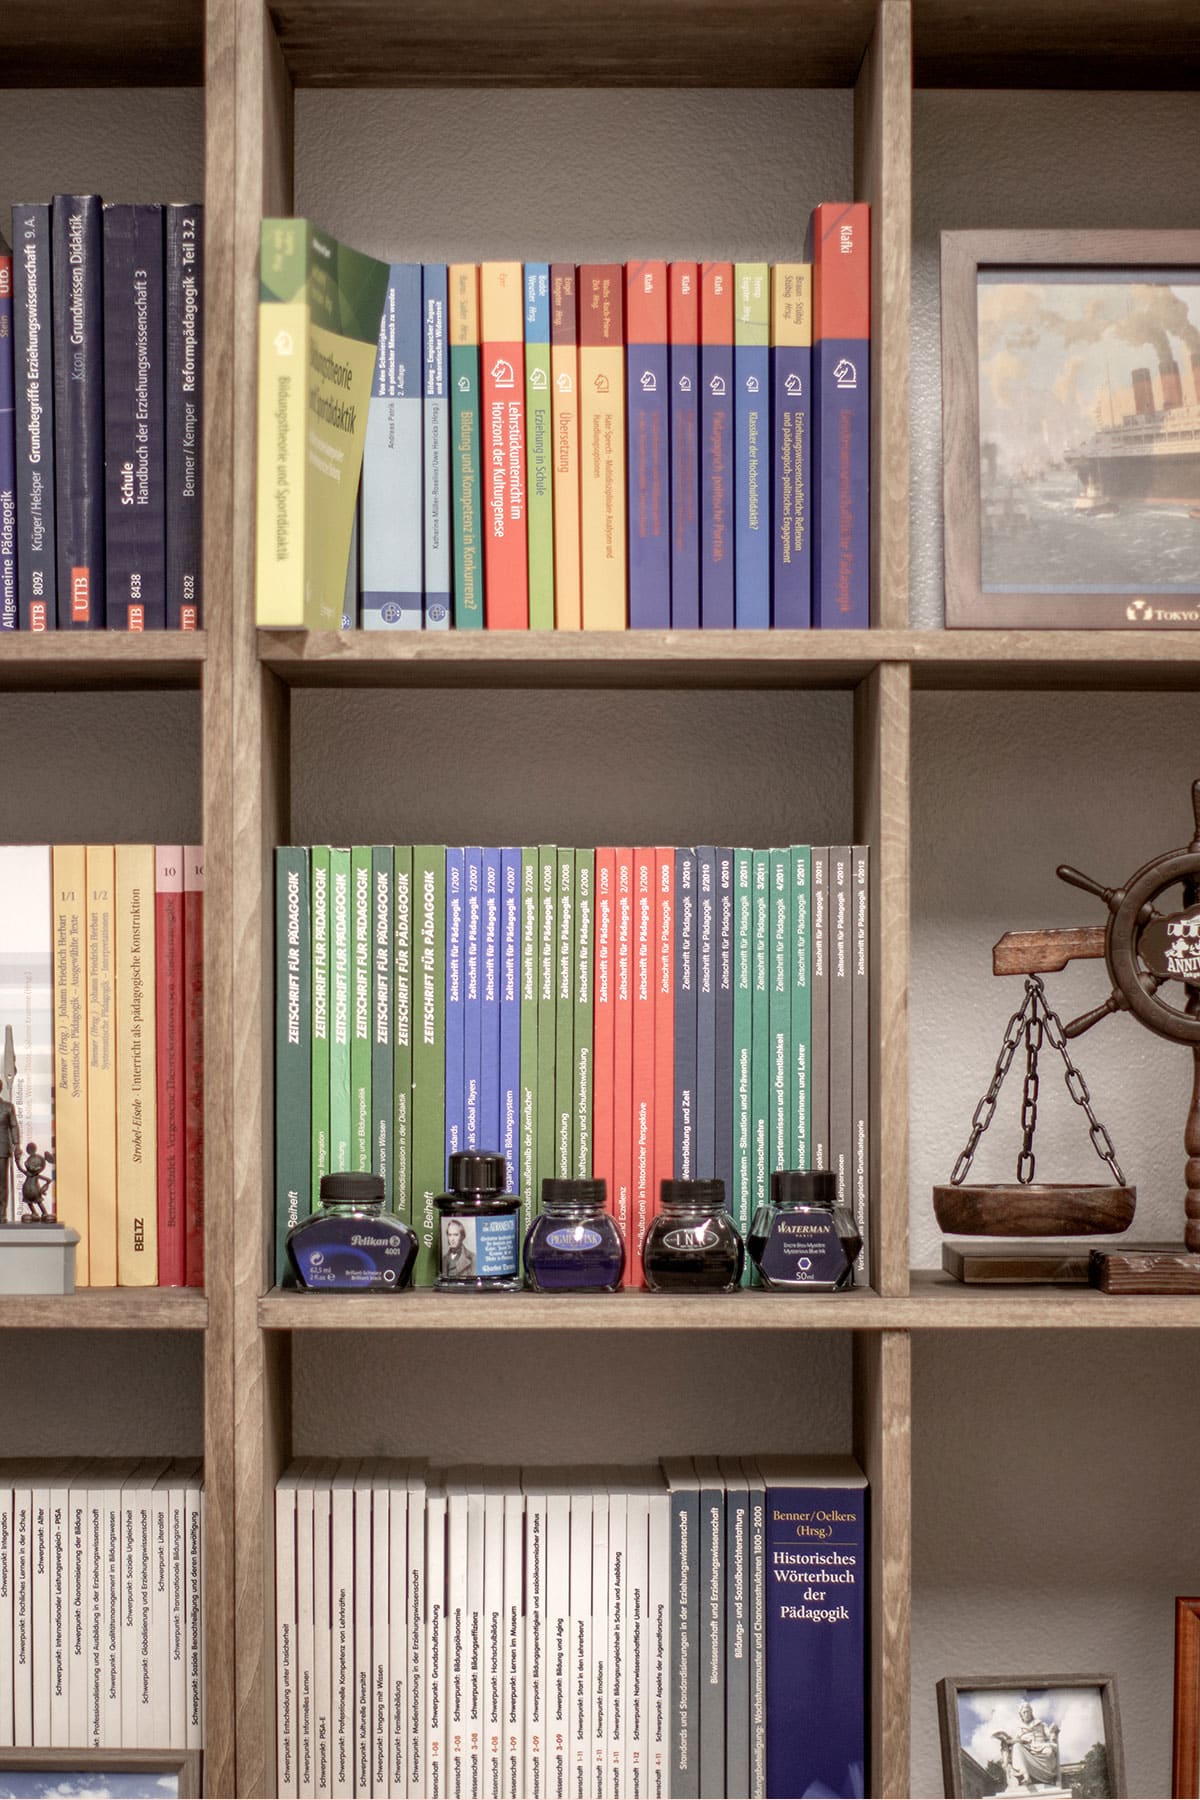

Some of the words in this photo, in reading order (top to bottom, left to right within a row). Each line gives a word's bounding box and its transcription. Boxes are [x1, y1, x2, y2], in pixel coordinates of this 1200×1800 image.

[68, 214, 82, 264] Didaktik
[182, 219, 195, 240] 3.2
[840, 226, 852, 253] Klafki
[135, 270, 147, 278] 3
[182, 244, 195, 266] Teil
[644, 274, 653, 294] Klafki
[681, 276, 690, 295] Klafki
[714, 276, 723, 296] Klafki
[23, 244, 41, 380] Erziehungswissenschaft
[70, 268, 84, 344] Grundwissen
[135, 282, 151, 419] Erziehungswissenschaft
[181, 276, 198, 392] Reformpädagogik
[71, 352, 84, 380] Kron
[28, 382, 44, 463] Grundbegriffe
[136, 424, 148, 442] der
[459, 412, 472, 451] Bildung
[492, 402, 504, 446] Horizont
[533, 410, 546, 454] Erziehung
[749, 412, 758, 444] Klassiker
[784, 412, 792, 426] und
[493, 449, 505, 466] der
[508, 402, 522, 504] Lehrstückunterricht
[536, 456, 546, 464] in
[558, 412, 572, 473] Übersetzung
[749, 446, 758, 458] der
[136, 446, 149, 504] Handbuch
[277, 465, 288, 486] und
[462, 454, 472, 472] und
[536, 466, 546, 496] Schule
[121, 462, 134, 505] Schule
[460, 476, 474, 532] Kompetenz
[490, 469, 506, 537] Kulturgenese
[510, 506, 522, 520] im
[0, 490, 15, 555] Pädagogik
[274, 489, 289, 560] Sportdidaktik
[464, 535, 474, 544] in
[780, 517, 792, 564] Engagement
[2, 560, 17, 628] Allgemeine
[33, 572, 44, 596] 8092
[75, 578, 88, 610] UTB
[131, 574, 142, 599] 8438
[184, 575, 194, 600] 8282
[464, 547, 477, 610] Konkurrenz?
[33, 604, 44, 631] UTB
[1154, 610, 1199, 621] TOKYO
[130, 888, 141, 954] Konstruktion
[287, 872, 299, 945] PÄDAGOGIK
[314, 868, 326, 941] PÄDAGOGIK
[335, 873, 347, 946] PÄDAGOGIK
[356, 868, 368, 941] PÄDAGOGIK
[376, 872, 388, 945] PÄDAGOGIK
[396, 873, 409, 947] PÄDAGOGIK
[422, 871, 435, 945] PÄDAGOGIK
[450, 898, 461, 943] Pädagogik
[599, 900, 610, 944] Pädagogik
[58, 915, 67, 946] Herbart
[69, 914, 78, 934] Texte
[58, 948, 68, 986] Friedrich
[69, 938, 80, 986] Ausgewählte
[287, 948, 299, 971] FÜR
[314, 943, 326, 966] FÜR
[335, 948, 347, 971] FÜR
[356, 943, 368, 966] FÜR
[376, 948, 388, 971] FÜR
[396, 950, 409, 973] FÜR
[422, 948, 435, 971] FÜR
[450, 945, 459, 957] für
[599, 946, 608, 958] für
[131, 956, 144, 1022] pädagogische
[450, 960, 459, 1002] Zeitschrift
[599, 960, 608, 1002] Zeitschrift
[58, 988, 68, 1018] Johann
[70, 997, 80, 1038] Pädagogik
[288, 974, 299, 1044] ZEITSCHRIFT
[315, 967, 326, 1038] ZEITSCHRIFT
[336, 972, 347, 1044] ZEITSCHRIFT
[356, 967, 368, 1039] ZEITSCHRIFT
[377, 974, 388, 1044] ZEITSCHRIFT
[398, 976, 409, 1046] ZEITSCHRIFT
[424, 974, 435, 1044] ZEITSCHRIFT
[131, 1025, 141, 1038] als
[71, 1042, 83, 1098] Systematische
[132, 1040, 142, 1091] Unterricht
[740, 1048, 748, 1092] Prävention
[798, 1044, 806, 1071] Lehrer
[468, 1080, 478, 1105] Players
[578, 1048, 588, 1113] Schulentwicklung
[776, 1090, 784, 1105] und
[798, 1073, 806, 1088] und
[398, 1093, 406, 1122] Didaktik
[468, 1107, 476, 1131] Global
[740, 1094, 748, 1110] und
[798, 1090, 806, 1138] Lehrerinnen
[132, 1098, 142, 1164] Strobel-Eisele
[740, 1112, 748, 1148] Situation
[776, 1108, 786, 1171] Expertenwissen
[288, 1190, 299, 1228] Beiheft
[424, 1192, 434, 1228] Beiheft
[778, 1221, 830, 1233] WATERMAN
[134, 1218, 144, 1252] BELTZ
[351, 1235, 388, 1246] Pelikan
[424, 1232, 434, 1248] 40.
[74, 1509, 82, 1535] Bildung
[796, 1526, 833, 1539] (Hrsg.)
[55, 1532, 63, 1595] Leistungsvergleich
[680, 1511, 689, 1604] Erziehungswissenschaft
[734, 1509, 744, 1600] Sozialberichterstattung
[773, 1552, 856, 1565] Historisches
[74, 1550, 82, 1606] Ökonomisierung
[774, 1570, 855, 1583] Wörterbuch
[804, 1588, 826, 1601] der
[680, 1606, 688, 1619] der
[734, 1603, 743, 1618] und
[780, 1606, 850, 1622] Pädagogik
[74, 1608, 82, 1655] Schwerpunkt:
[432, 1605, 440, 1679] Grundschulforschung
[734, 1621, 744, 1658] Bildungs-
[55, 1649, 63, 1696] Schwerpunkt:
[680, 1632, 689, 1709] Standardisierungen
[283, 1689, 291, 1734] Entscheidung
[432, 1681, 440, 1728] Schwerpunkt:
[680, 1711, 688, 1727] und
[283, 1736, 291, 1783] Schwerpunkt:
[680, 1729, 688, 1770] Standards
